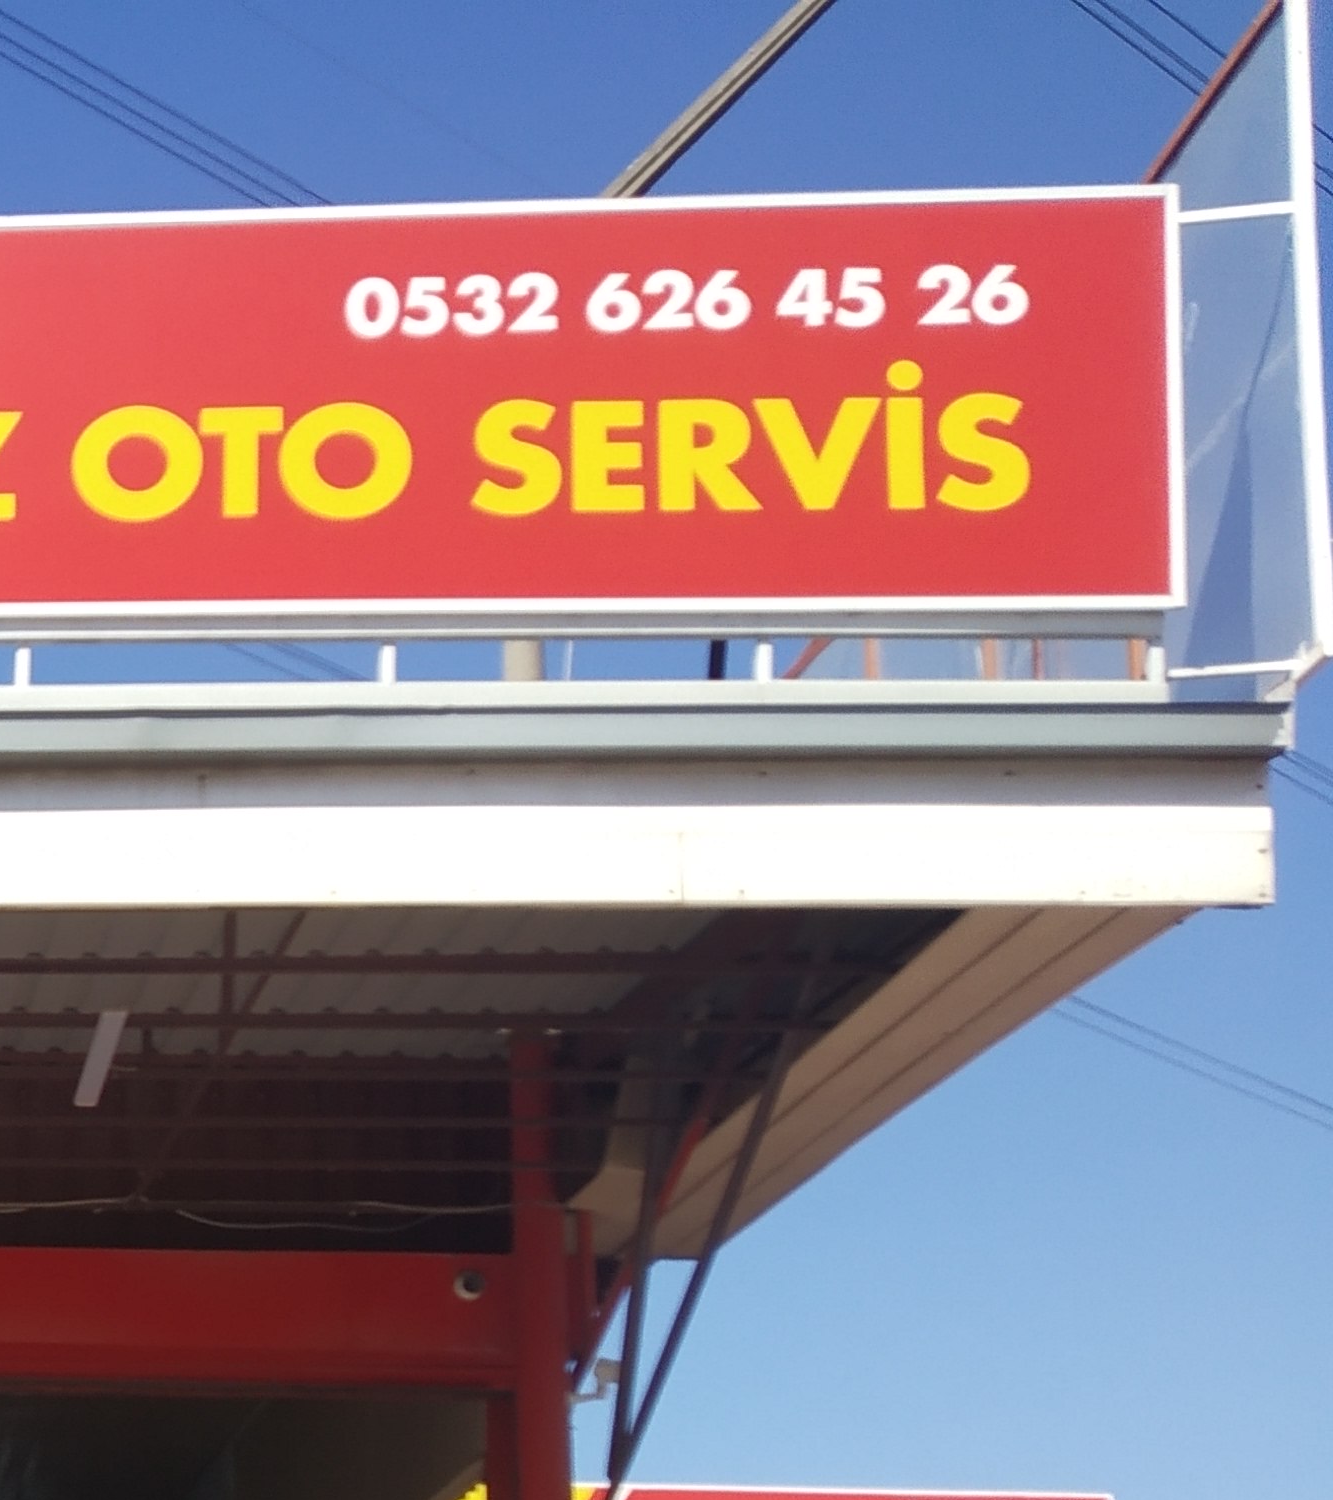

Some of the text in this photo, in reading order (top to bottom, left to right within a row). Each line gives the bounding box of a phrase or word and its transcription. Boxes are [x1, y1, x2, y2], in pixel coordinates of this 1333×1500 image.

[343, 263, 1030, 340] 0532 626 45 26
[69, 401, 414, 523] OTO
[470, 359, 1031, 517] SERVİS
